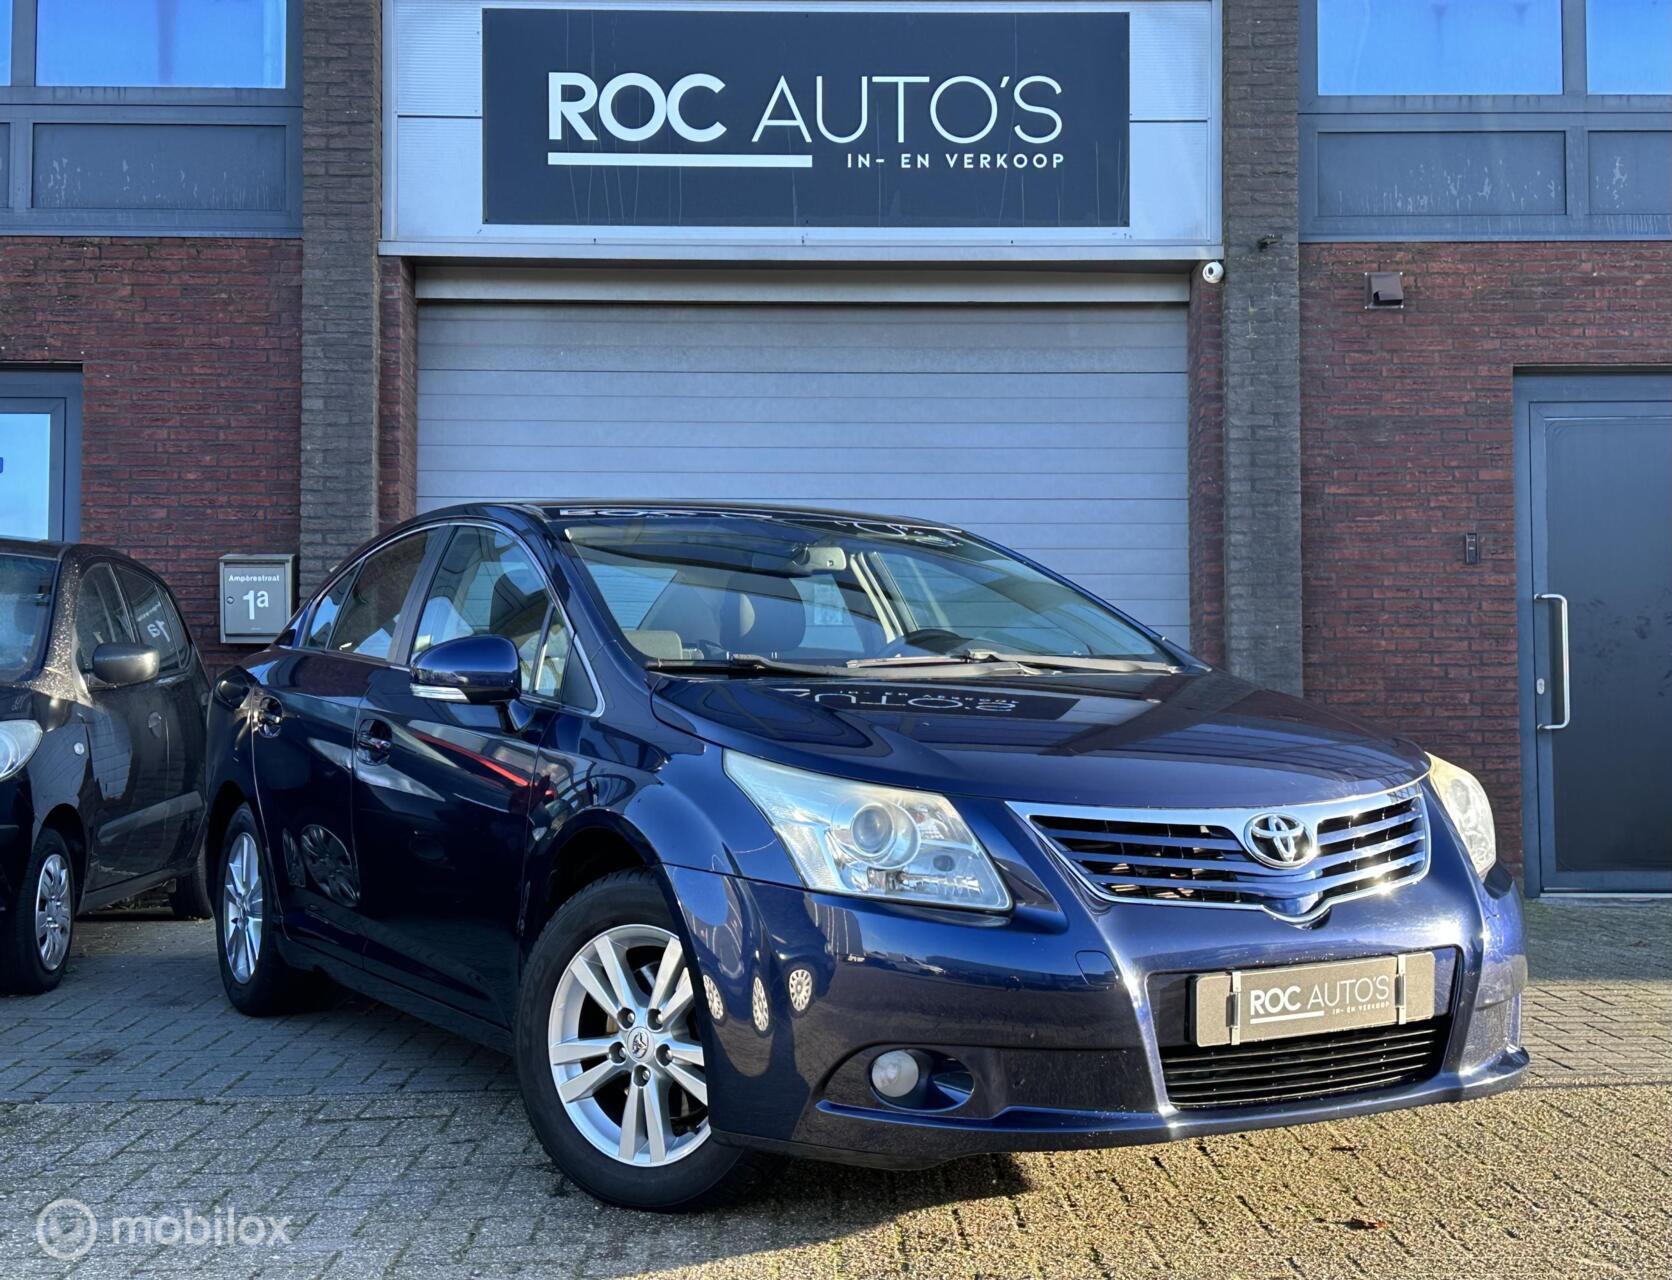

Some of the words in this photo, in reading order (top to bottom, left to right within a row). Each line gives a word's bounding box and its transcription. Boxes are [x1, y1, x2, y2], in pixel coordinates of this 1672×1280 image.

[548, 71, 727, 142] ROC
[751, 75, 1063, 144] AUTO'S
[847, 153, 885, 169] IN-
[900, 153, 930, 169] EN
[945, 153, 1064, 169] VERKOOP
[242, 590, 269, 620] 1a
[1250, 985, 1302, 1016] ROC
[1307, 975, 1390, 1010] AUTO'S
